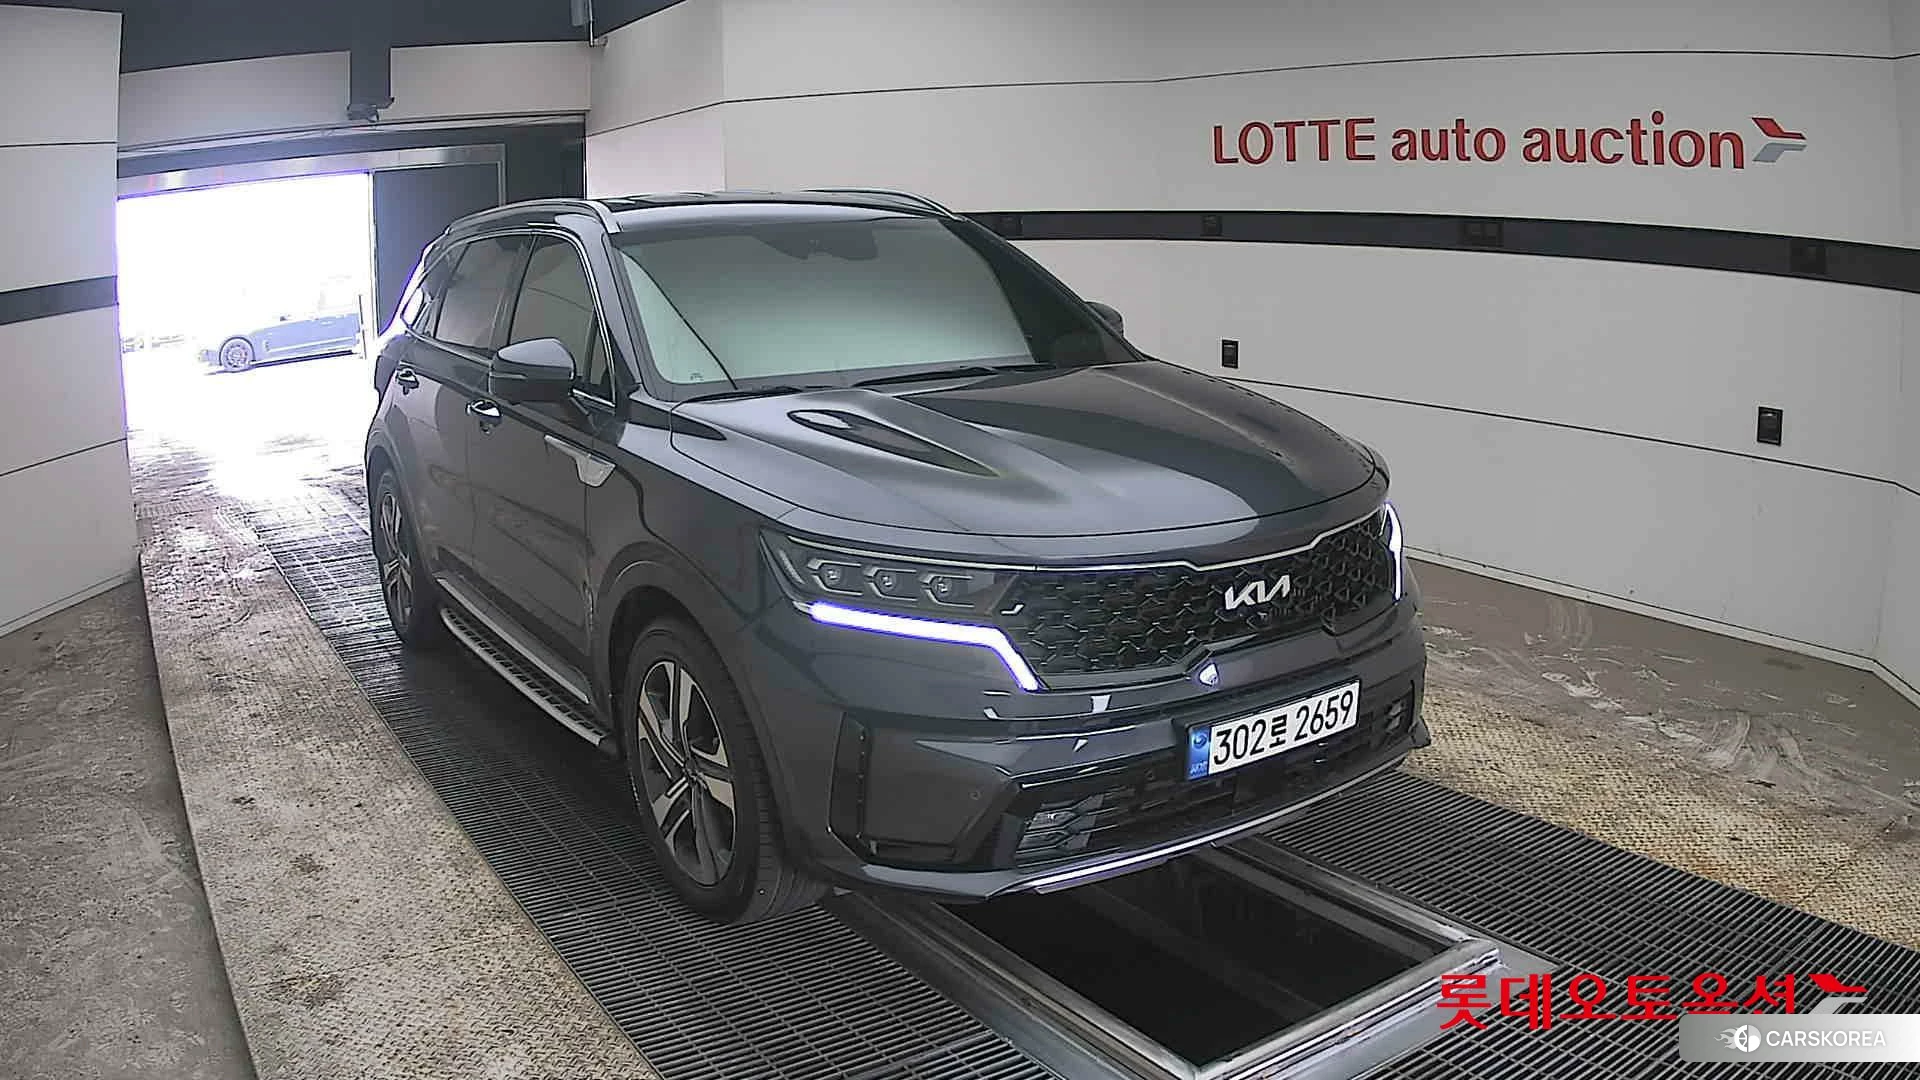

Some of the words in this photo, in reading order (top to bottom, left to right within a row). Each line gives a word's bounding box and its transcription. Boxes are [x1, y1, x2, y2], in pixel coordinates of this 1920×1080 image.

[1213, 117, 1376, 165] LOTTE
[1391, 117, 1507, 162] auto
[1522, 110, 1745, 170] auction
[1213, 713, 1288, 765] 302로
[1294, 690, 1354, 742] 2659
